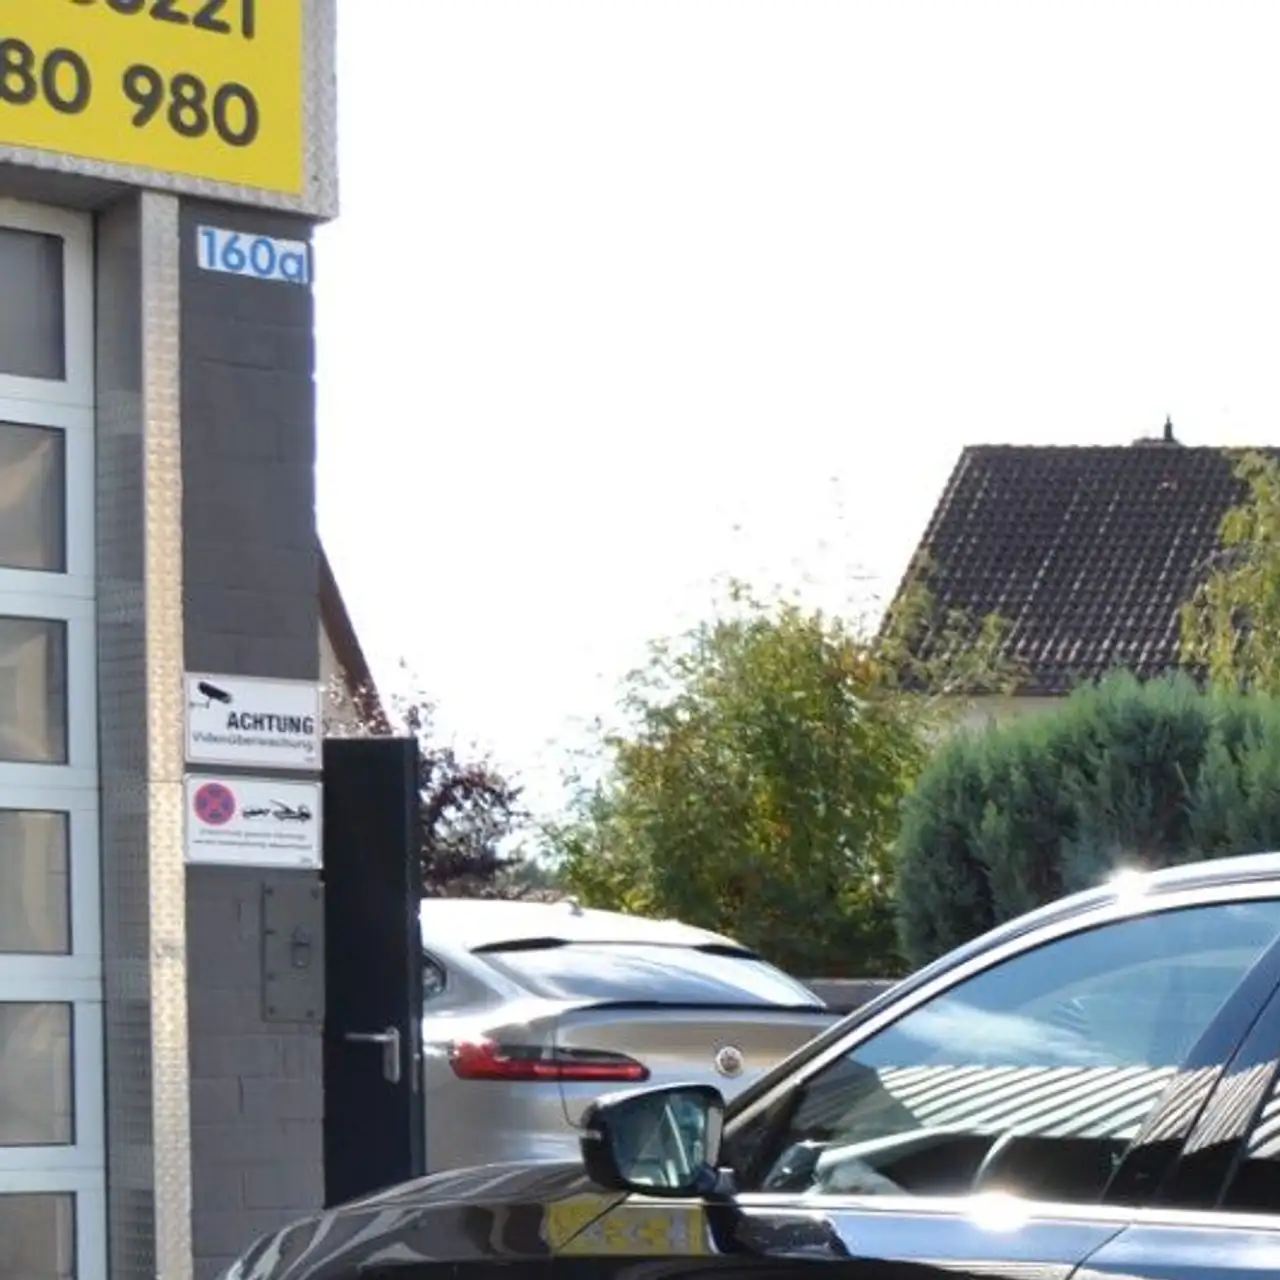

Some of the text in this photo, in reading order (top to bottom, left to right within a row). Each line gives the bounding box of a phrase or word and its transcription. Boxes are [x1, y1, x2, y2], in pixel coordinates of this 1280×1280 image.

[122, 63, 259, 147] 980
[202, 229, 304, 281] 160a
[227, 711, 314, 735] ACHTUNG
